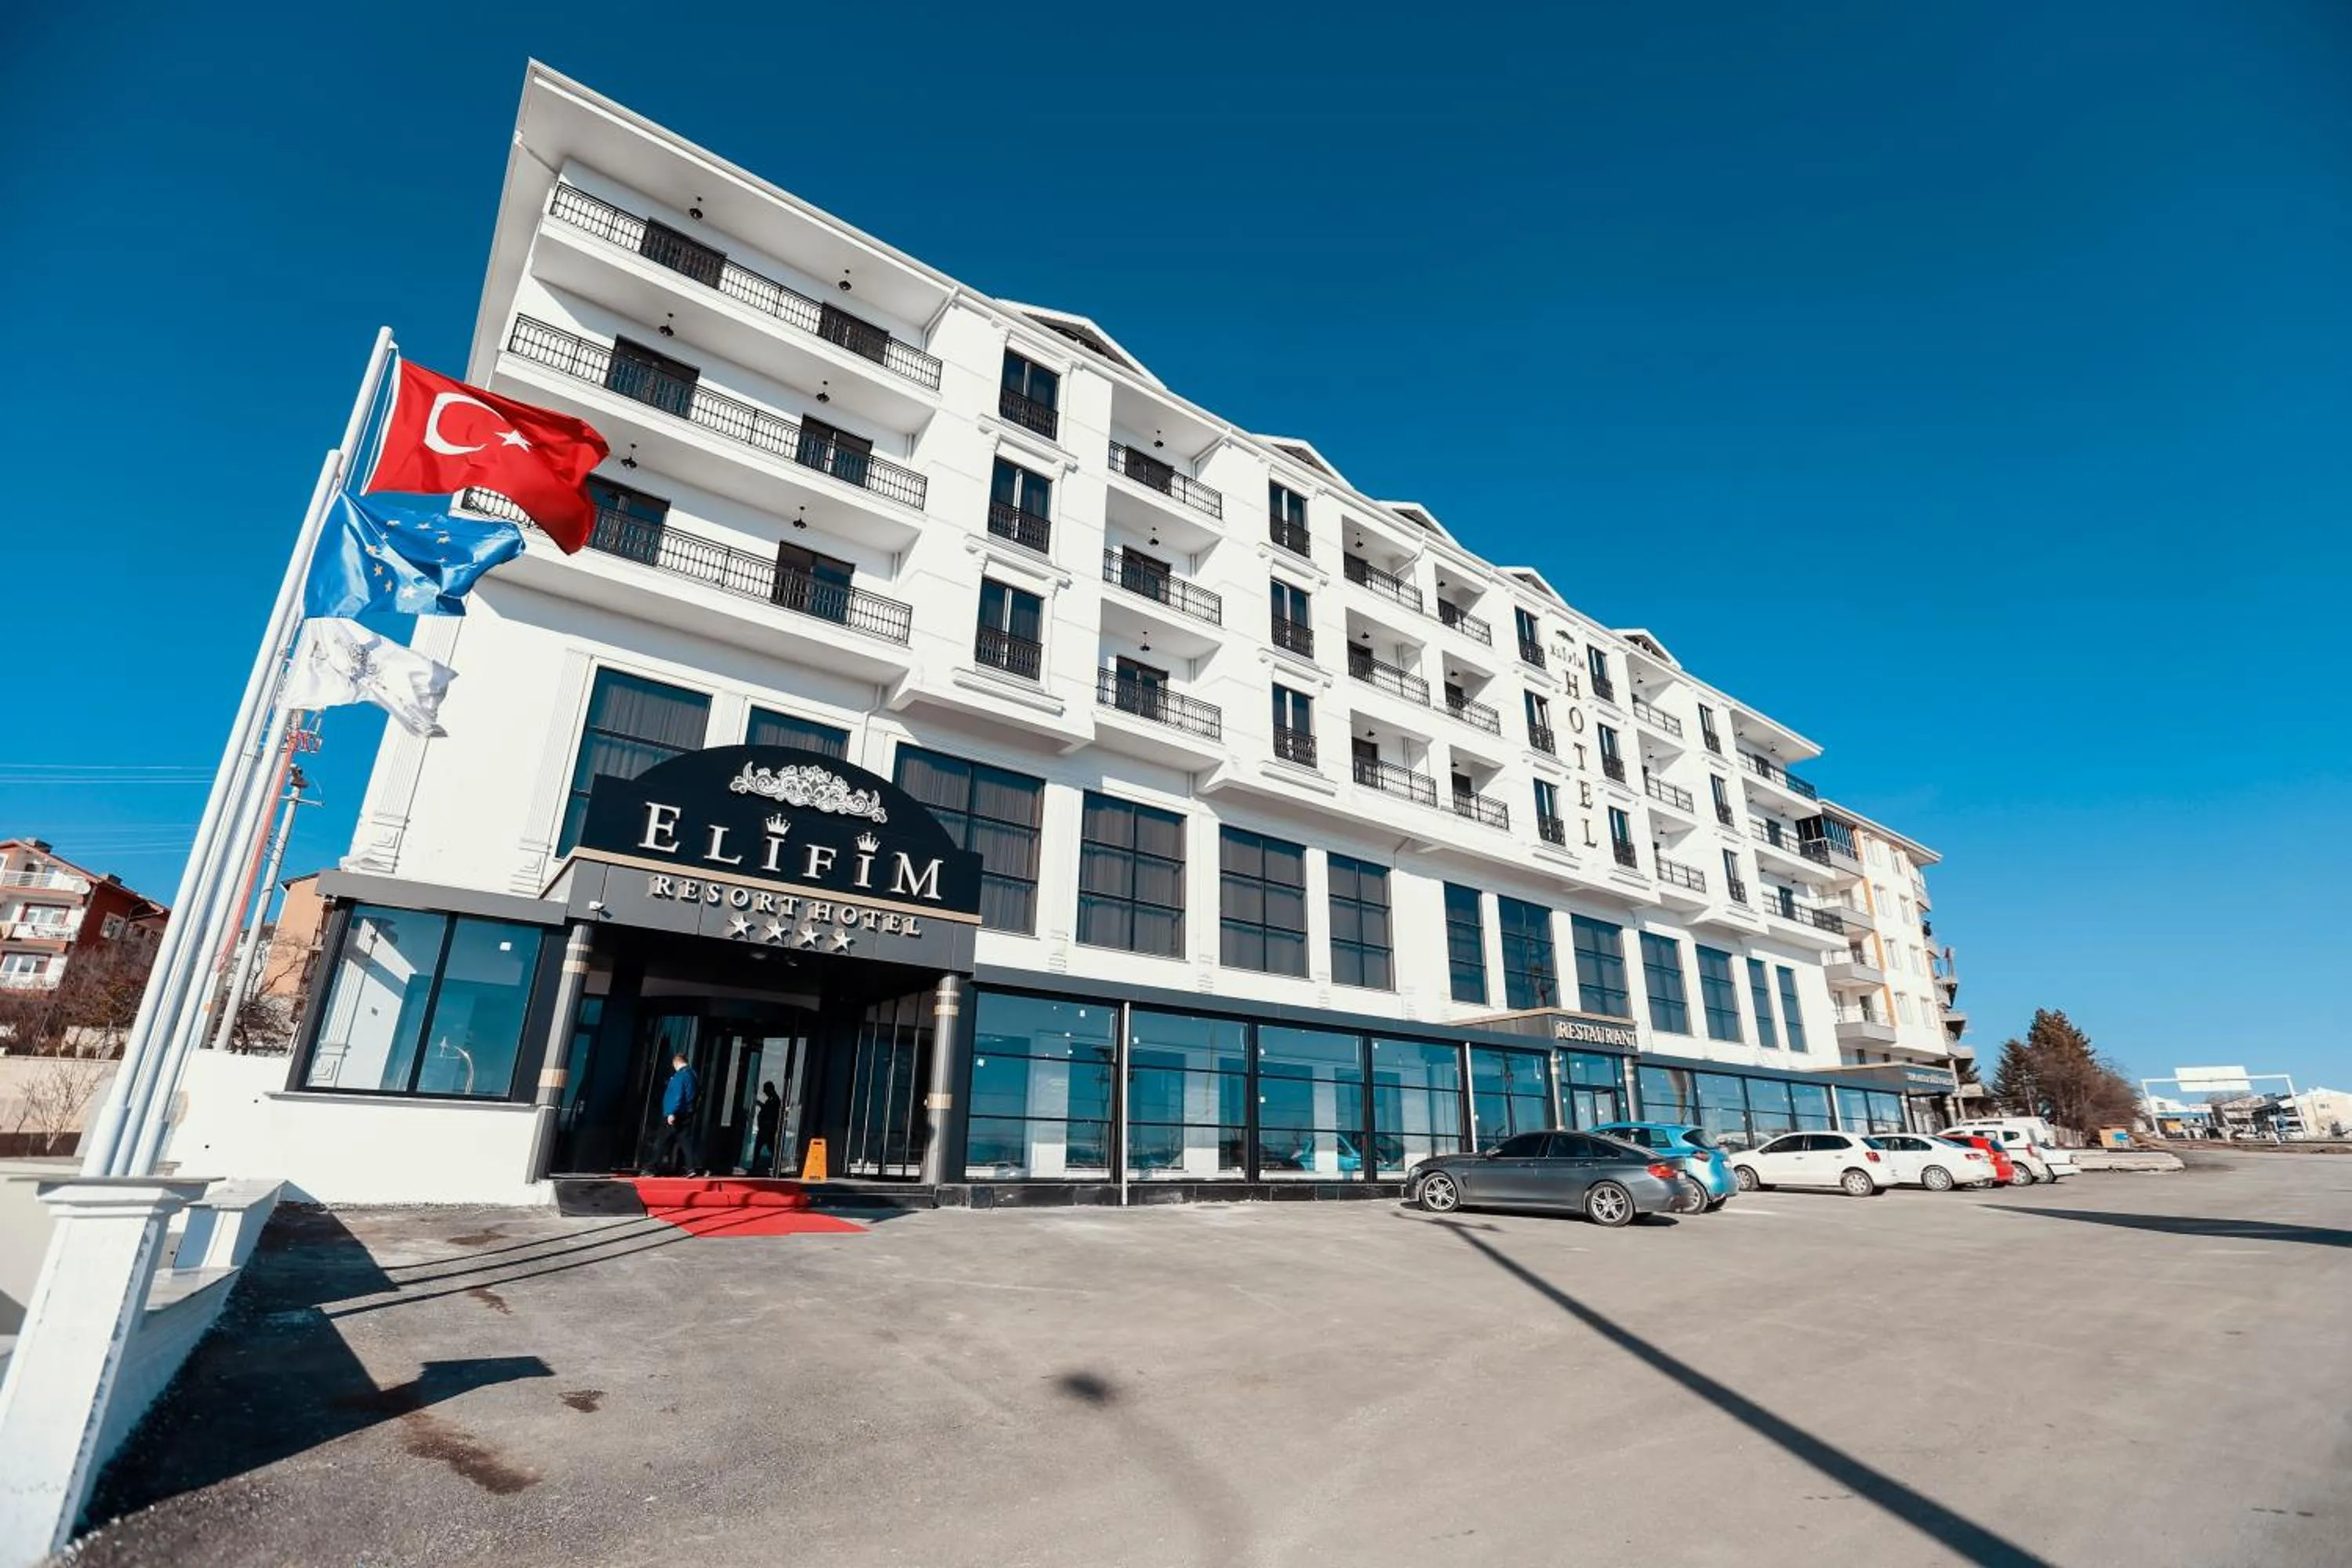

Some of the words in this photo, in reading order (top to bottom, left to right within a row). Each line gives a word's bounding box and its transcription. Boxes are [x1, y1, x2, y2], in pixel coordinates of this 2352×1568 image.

[1565, 670, 1598, 848] HOTEL
[653, 875, 799, 916] RESORT
[811, 901, 921, 935] HOTEL
[1556, 1021, 1636, 1047] RESTAURANT
